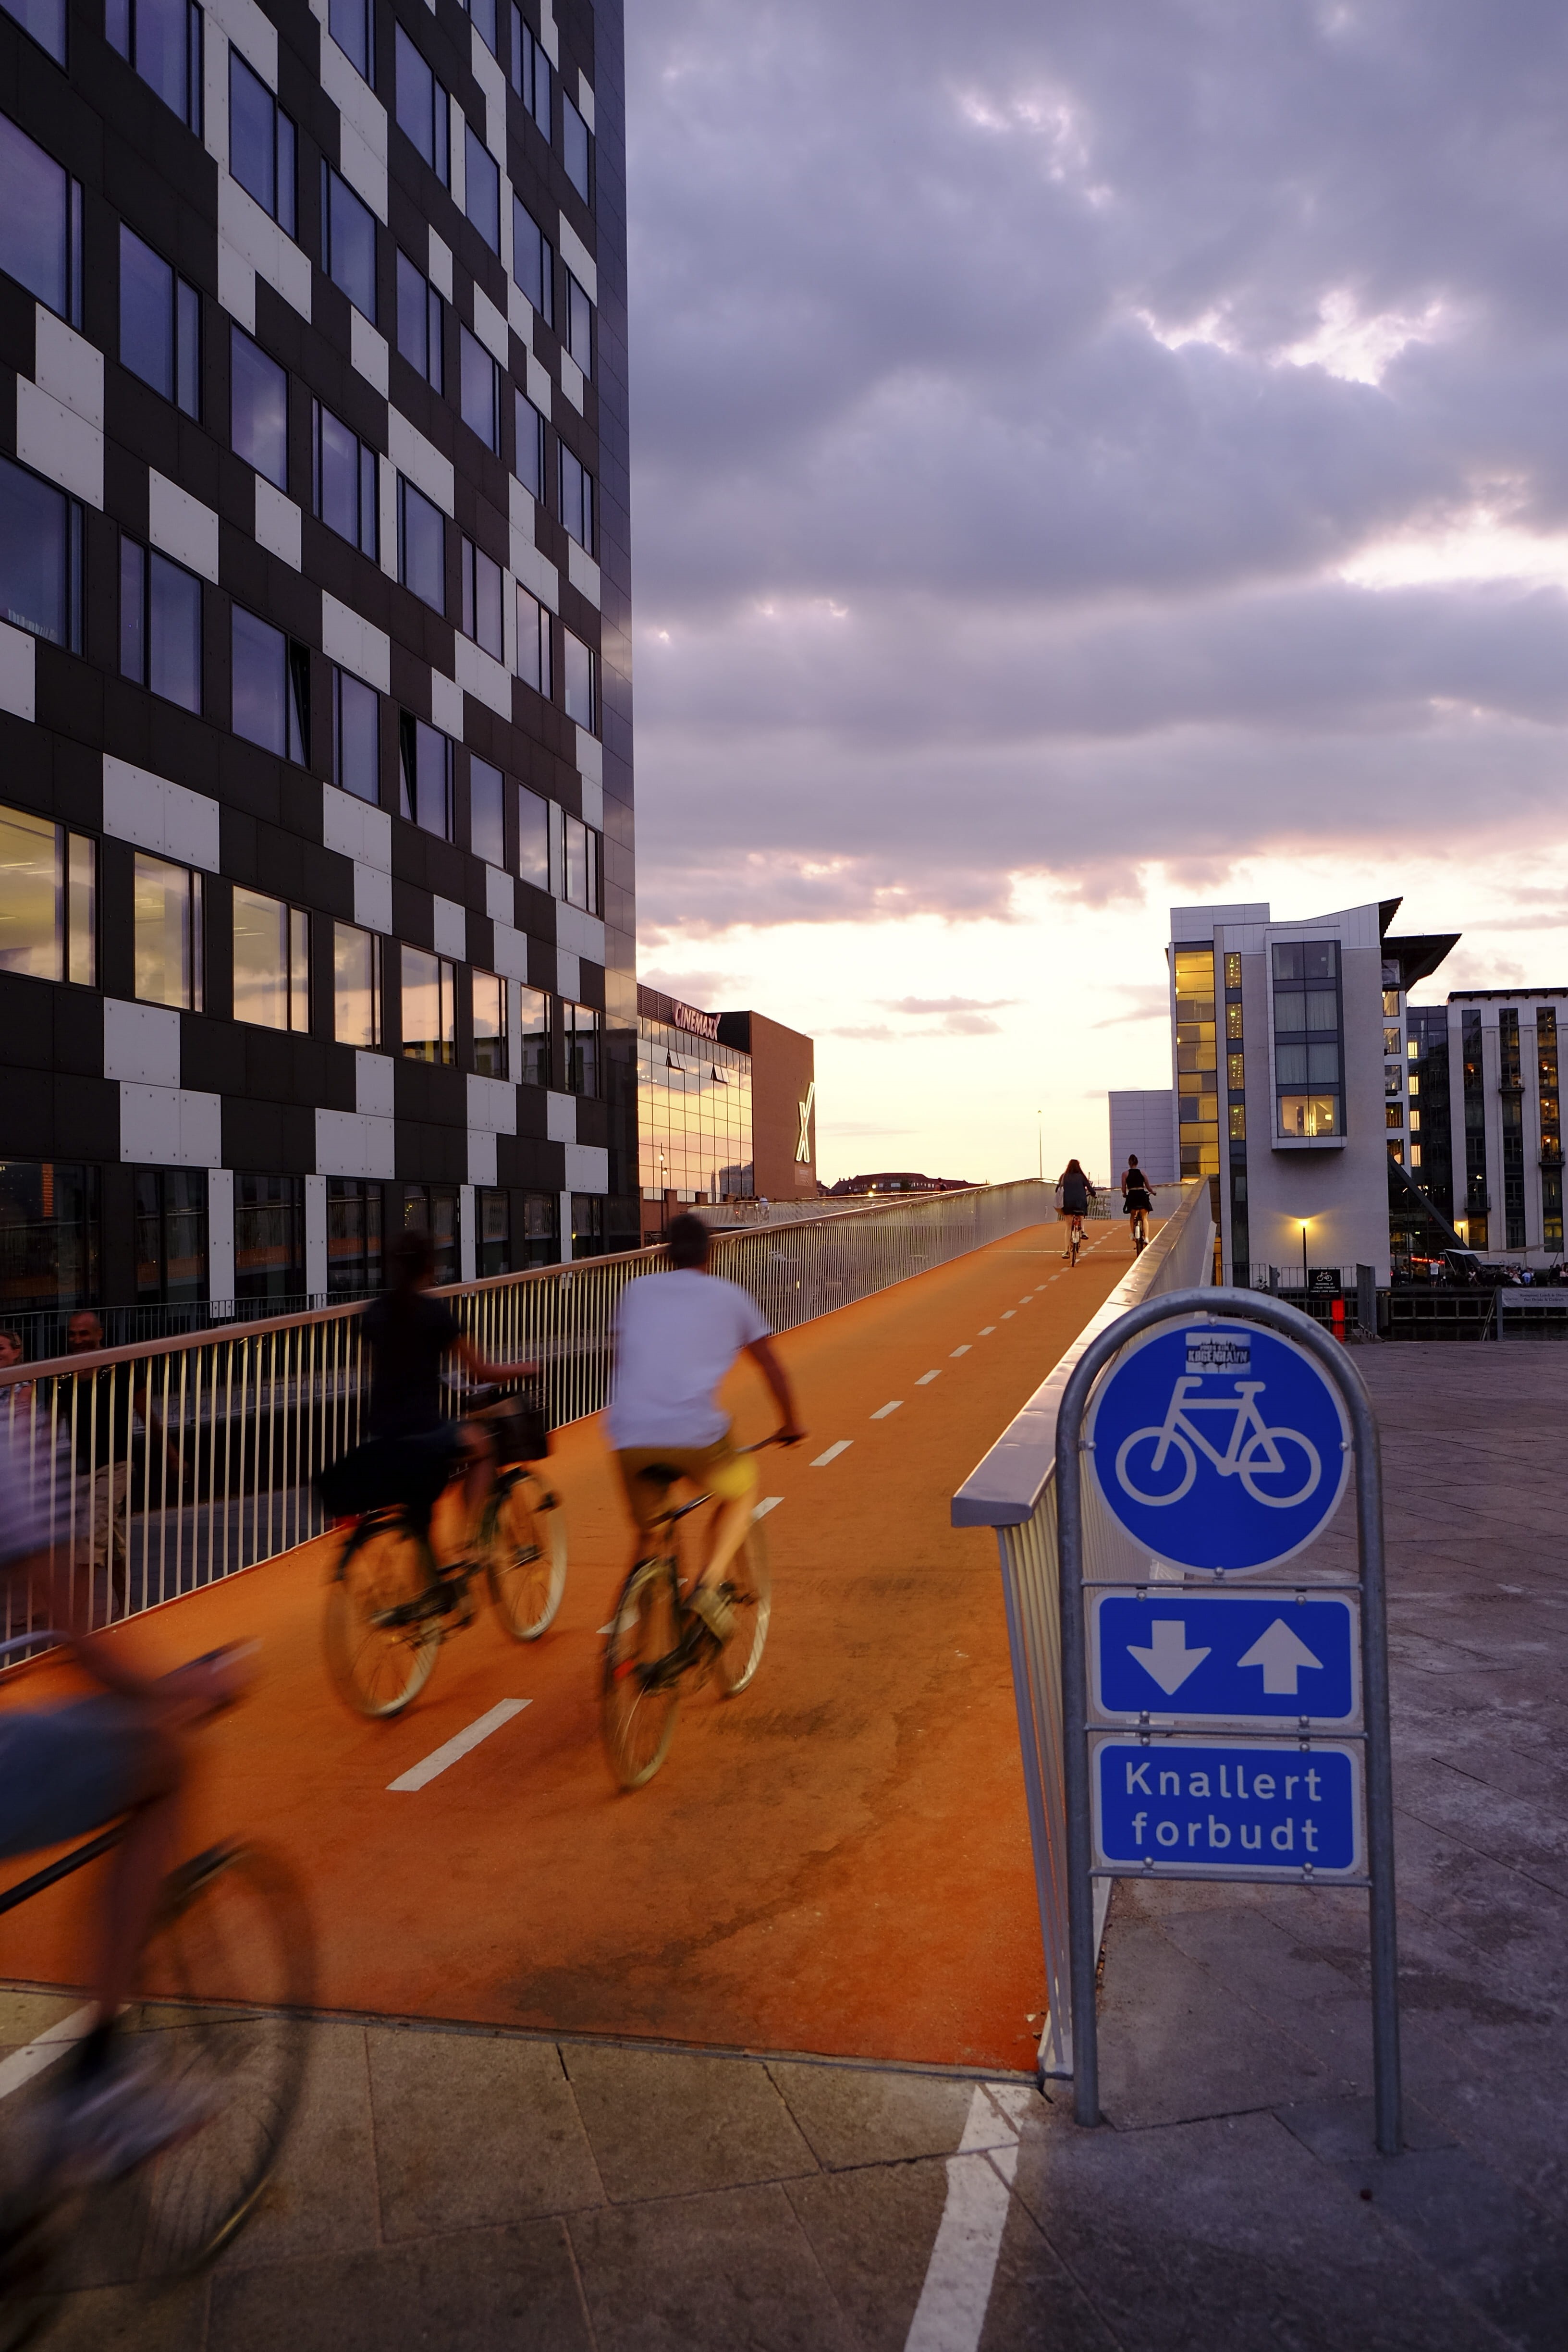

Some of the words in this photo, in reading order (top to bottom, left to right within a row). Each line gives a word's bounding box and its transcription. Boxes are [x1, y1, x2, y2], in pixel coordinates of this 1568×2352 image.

[674, 1002, 722, 1041] CINEMAXX
[796, 1081, 815, 1163] X
[1126, 1761, 1322, 1801] Knallert
[1132, 1812, 1318, 1852] forbudt
